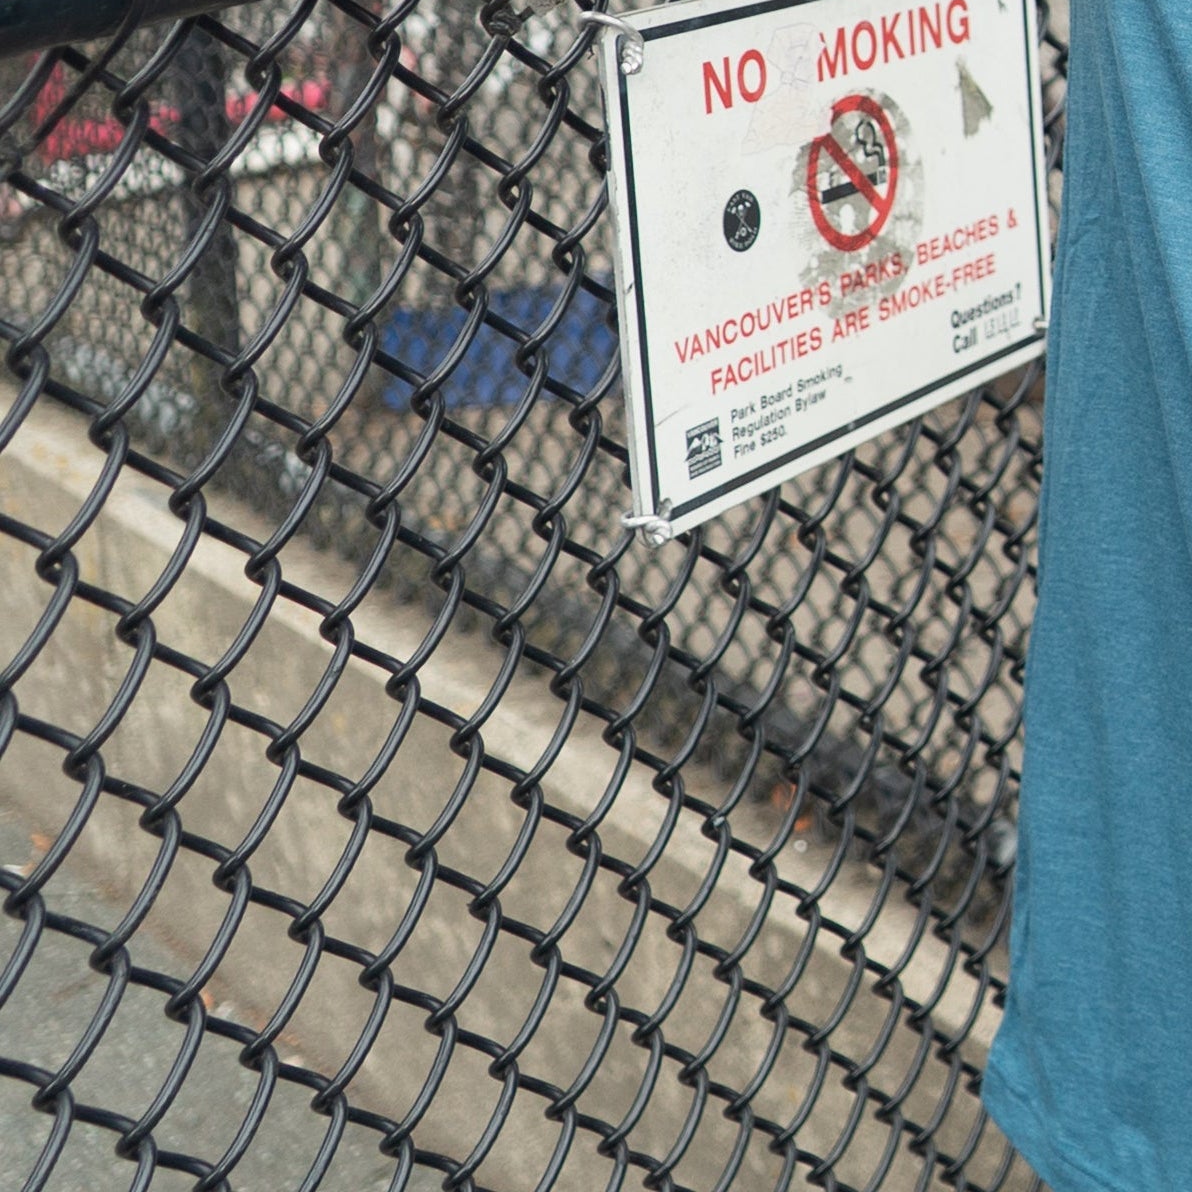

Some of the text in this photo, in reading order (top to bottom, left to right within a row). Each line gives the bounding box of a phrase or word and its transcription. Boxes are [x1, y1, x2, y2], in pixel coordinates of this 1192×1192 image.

[702, 49, 767, 114] NO
[916, 215, 999, 265] BEACHES
[1007, 208, 1018, 228] &
[711, 254, 996, 395] FACILITIES ARE SMOKE-FREE
[951, 283, 1021, 328] Questions?
[953, 326, 977, 353] Call
[730, 364, 842, 423] Park Board Smoking
[732, 405, 791, 441] Regulation
[795, 389, 826, 412] Bylaw
[734, 440, 756, 458] Fine
